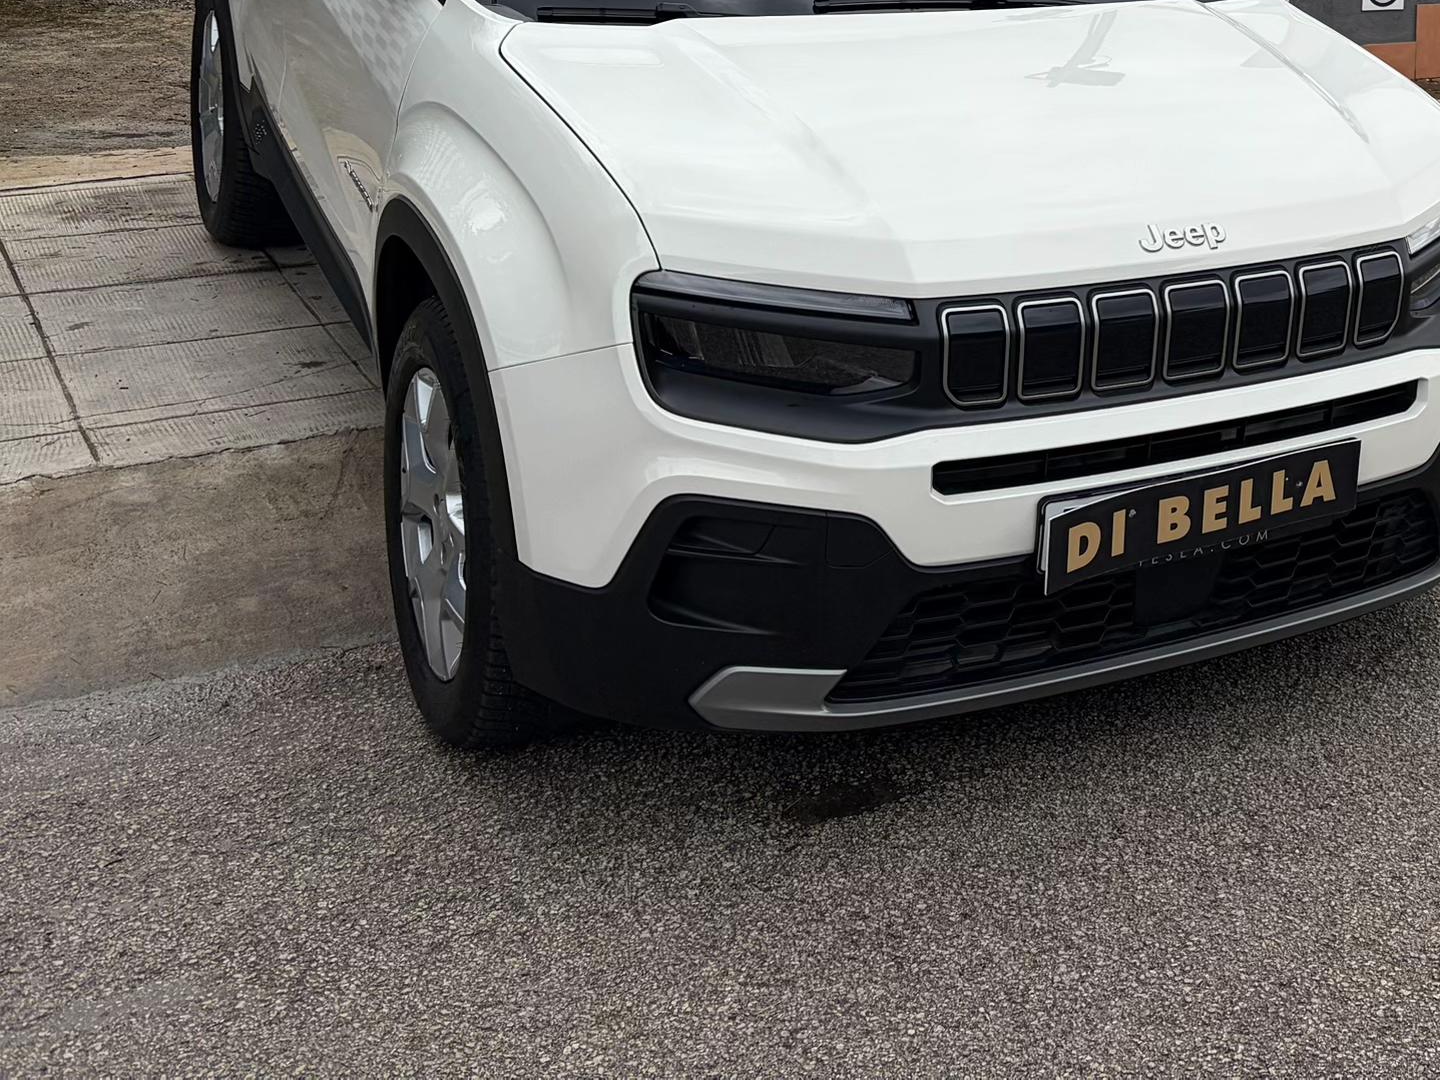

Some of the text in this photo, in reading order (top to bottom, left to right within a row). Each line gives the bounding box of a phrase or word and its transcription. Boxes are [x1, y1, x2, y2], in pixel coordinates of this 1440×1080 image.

[1138, 223, 1227, 254] Jeep
[1066, 459, 1337, 574] DI BELLA
